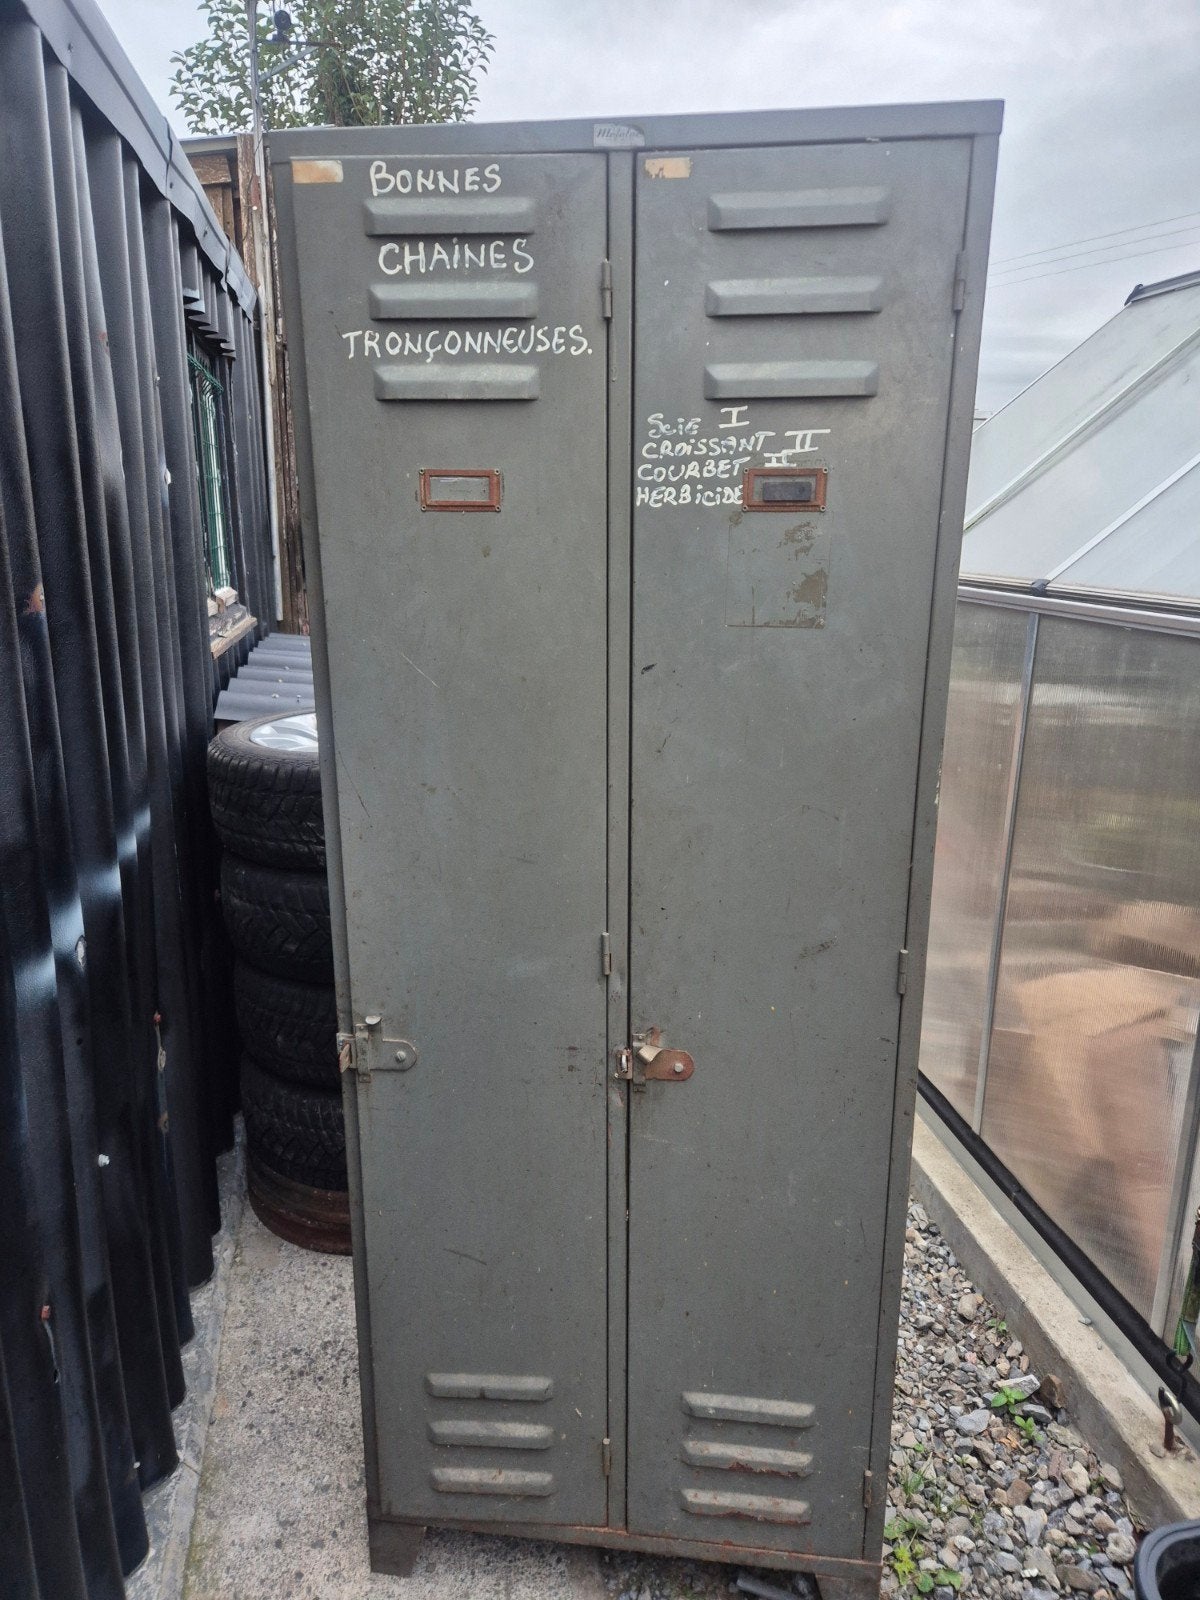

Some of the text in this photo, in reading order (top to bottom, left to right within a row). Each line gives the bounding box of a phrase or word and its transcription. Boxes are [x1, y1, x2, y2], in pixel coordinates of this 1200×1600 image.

[370, 160, 502, 196] BONNES
[342, 324, 593, 363] TRONÇONNEUSES.
[637, 456, 751, 482] COURBET
